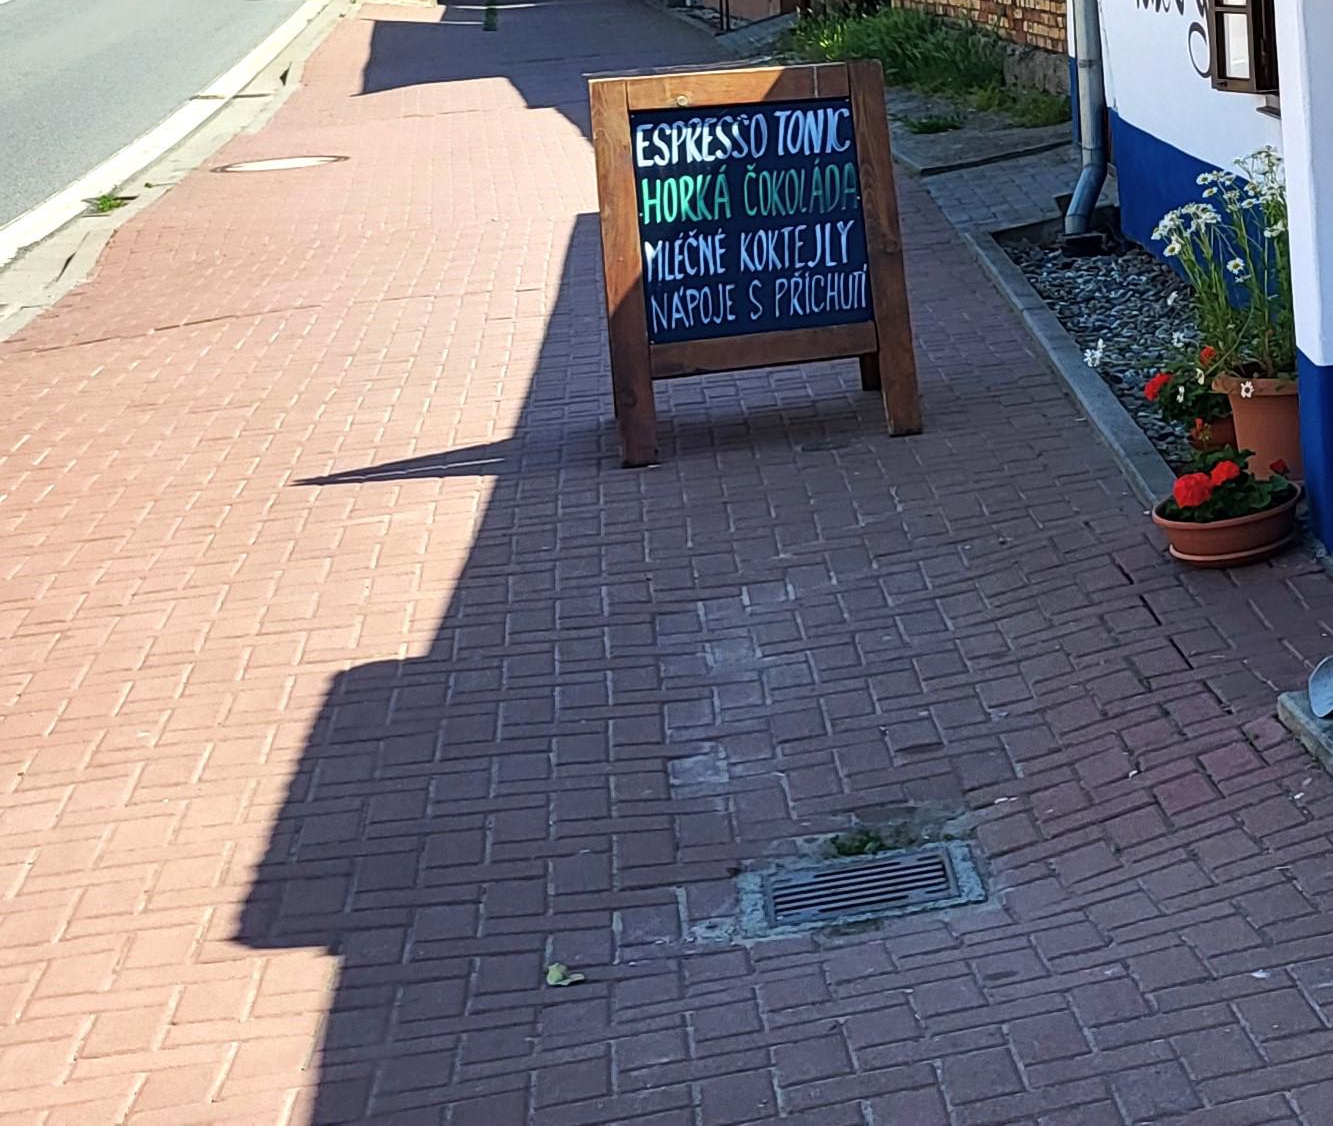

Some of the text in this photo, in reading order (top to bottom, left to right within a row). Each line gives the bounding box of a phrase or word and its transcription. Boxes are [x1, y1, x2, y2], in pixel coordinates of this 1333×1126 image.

[636, 107, 851, 168] ESPRESSO TONIC
[641, 157, 858, 225] HORKÁ ČOKOLÁDA
[644, 220, 855, 283] MLÉČNÉ KOKTEJLY
[650, 264, 867, 335] NÁPOJE S PŘÍCHUTÍ
